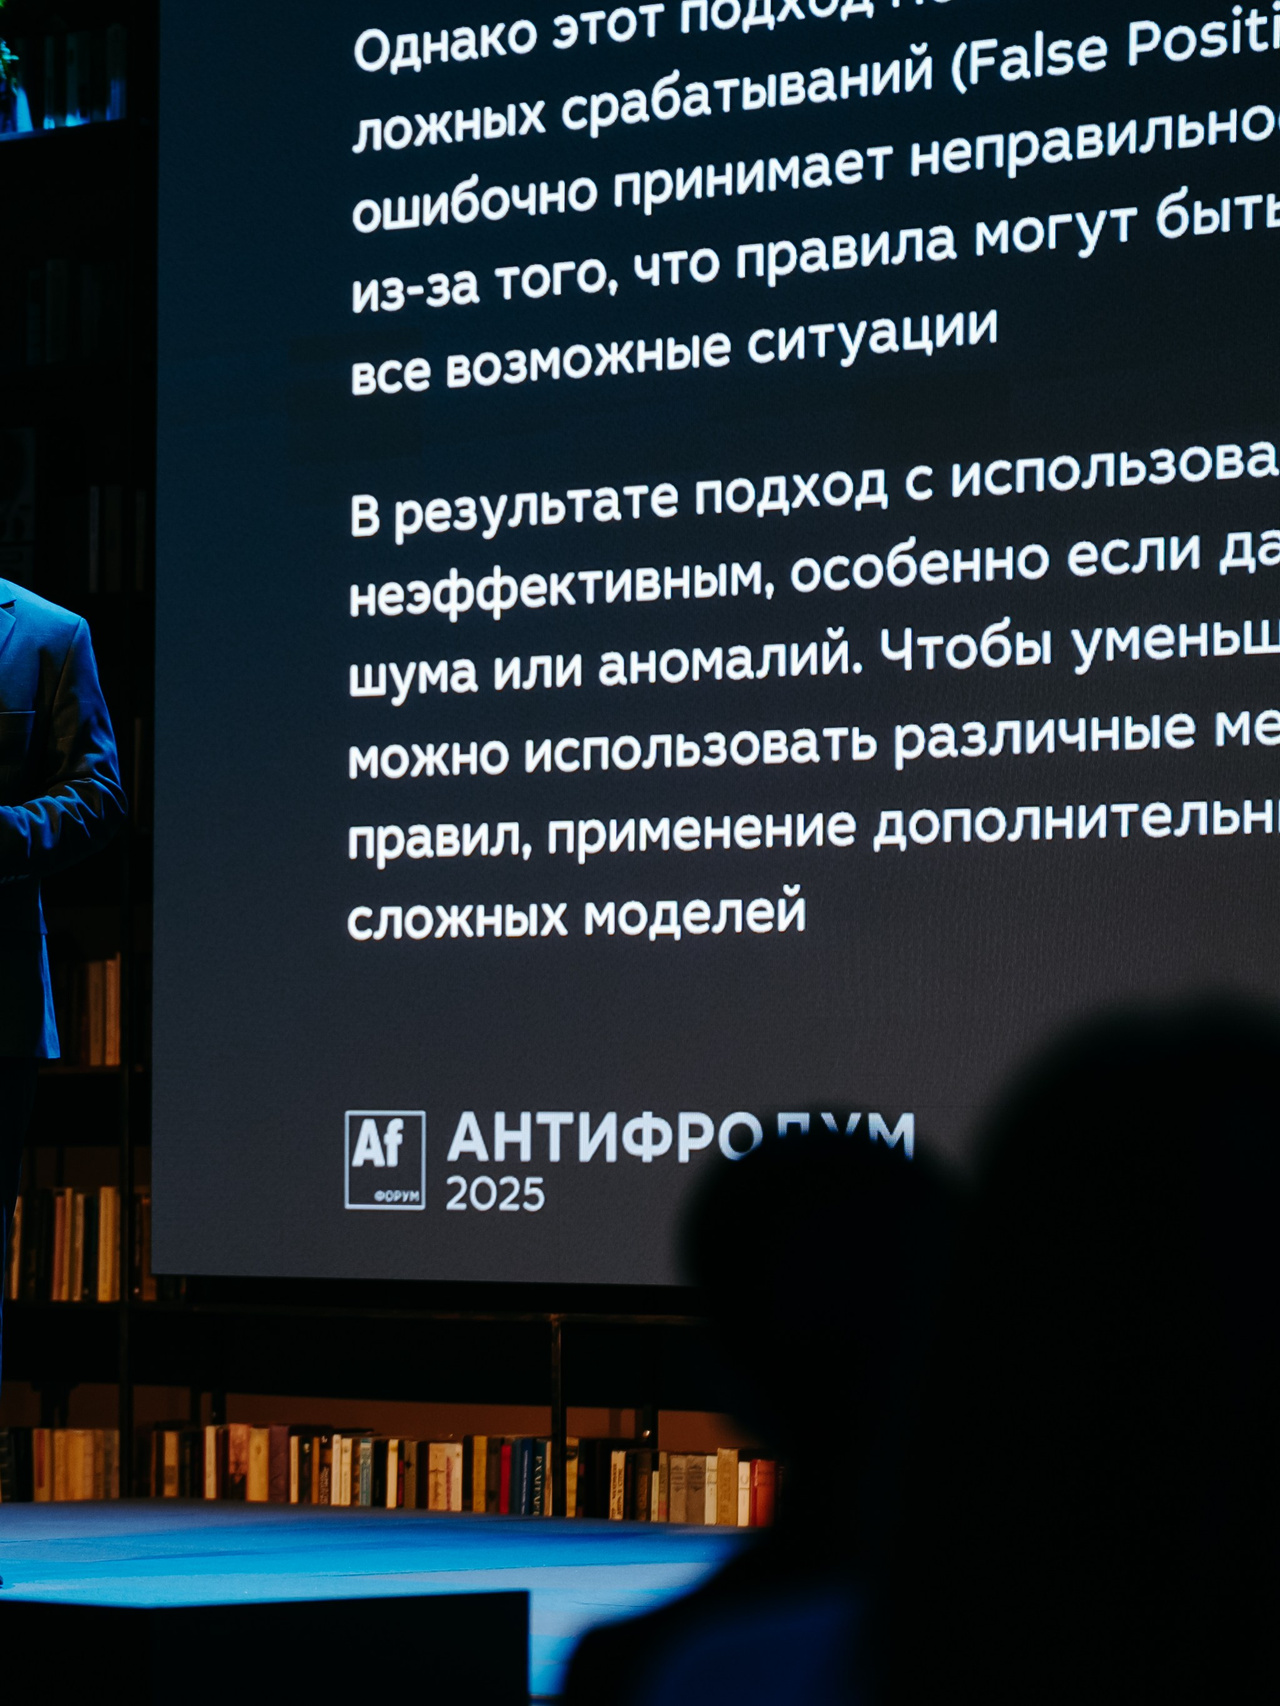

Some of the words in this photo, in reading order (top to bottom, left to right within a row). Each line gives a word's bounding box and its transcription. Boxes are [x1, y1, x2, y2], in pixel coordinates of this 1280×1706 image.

[353, 18, 538, 76] Однако
[552, 2, 666, 50] этот
[351, 99, 547, 154] ложных
[561, 41, 933, 139] срабатываний
[950, 30, 1109, 95] (False
[352, 173, 598, 234] ошибочно
[613, 145, 894, 217] принимает
[910, 104, 1280, 179] неправильно
[352, 270, 481, 314] из-за
[493, 258, 619, 301] того,
[633, 247, 721, 287] что
[736, 224, 958, 288] правила
[975, 206, 1139, 259] могут
[351, 357, 432, 396] все
[446, 332, 732, 389] возможные
[747, 308, 998, 368] ситуации
[351, 493, 381, 538] В
[394, 482, 679, 546] результате
[695, 468, 889, 519] подход
[905, 464, 934, 501] с
[951, 440, 1280, 498] использова
[349, 560, 775, 624] неэффективным,
[790, 535, 1050, 593] особенно
[1067, 534, 1201, 577] если
[349, 658, 479, 707] шума
[493, 653, 582, 691] или
[598, 626, 863, 687] аномалий.
[880, 615, 1052, 672] Чтобы
[348, 740, 510, 780] можно
[524, 726, 878, 774] использовать
[894, 712, 1197, 771] различные
[348, 821, 533, 871] правил,
[547, 810, 857, 865] применение
[872, 798, 1280, 853] дополнительн
[347, 902, 569, 941] сложных
[584, 883, 806, 942] моделей
[351, 1117, 405, 1168] Af
[373, 1189, 420, 1203] ФОРУМ
[445, 1174, 546, 1212] 2025
